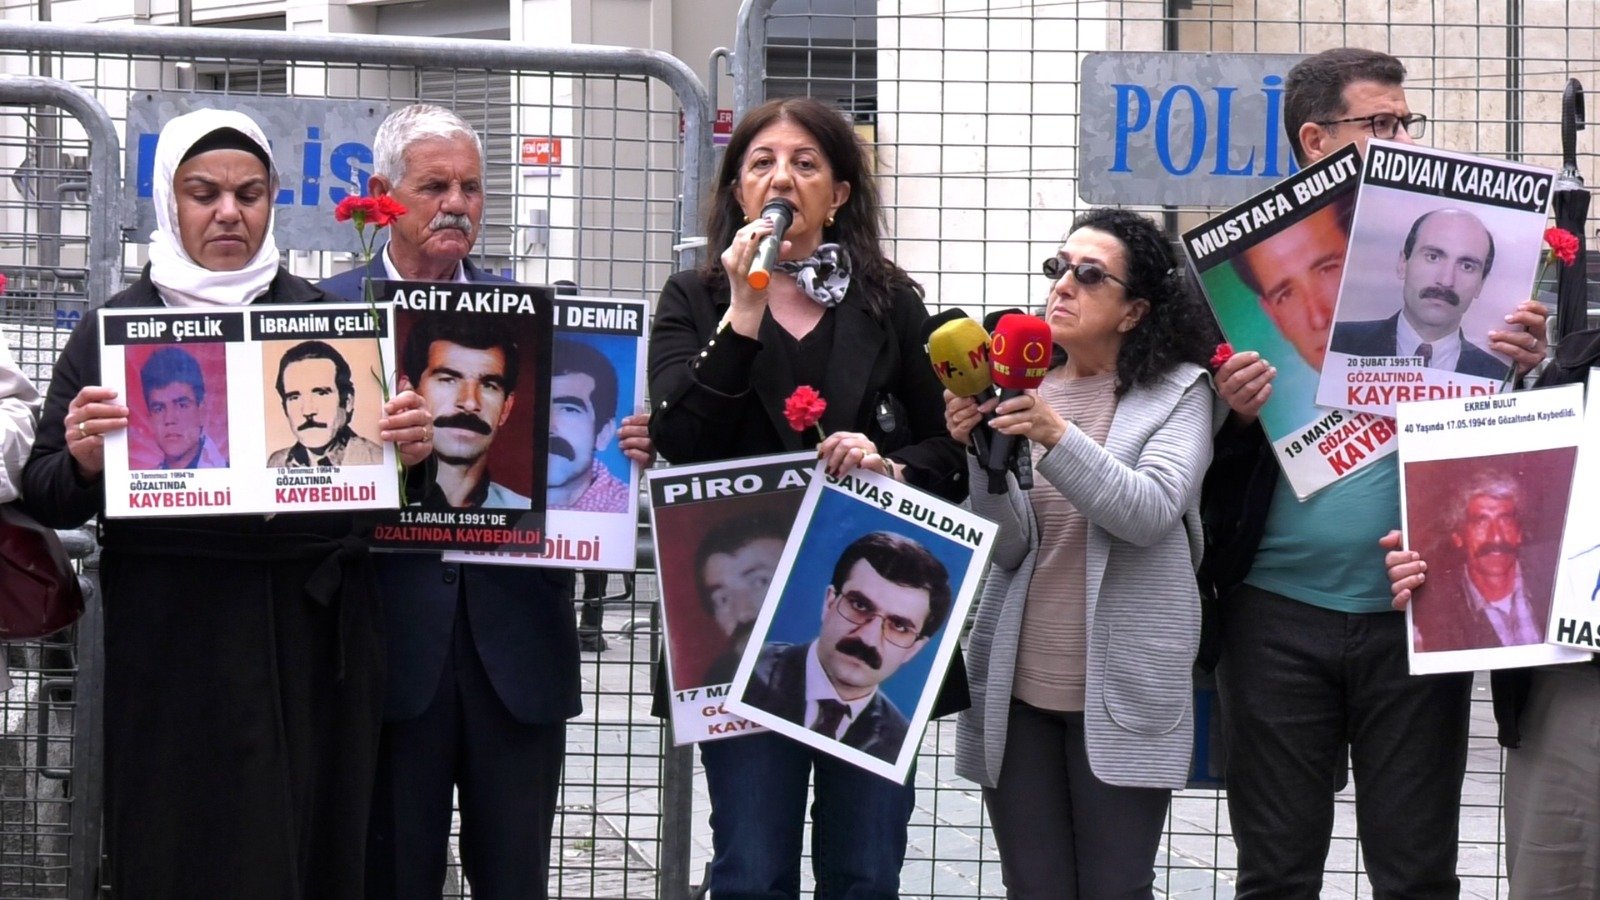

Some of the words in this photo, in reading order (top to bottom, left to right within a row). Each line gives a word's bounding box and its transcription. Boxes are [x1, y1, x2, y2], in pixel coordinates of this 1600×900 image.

[1108, 74, 1301, 177] POLİ
[1370, 150, 1448, 190] RIDVAN
[1451, 164, 1548, 212] KARAKOÇ
[1191, 193, 1293, 260] MUSTAFA
[1292, 153, 1358, 205] BULUT
[393, 285, 452, 311] AGİT
[455, 288, 536, 315] AKİPA
[126, 317, 166, 339] EDİP
[172, 315, 223, 341] ÇELİK
[259, 314, 330, 334] İBRAHİM
[566, 304, 638, 331] DEMİR
[1347, 358, 1358, 367] 20
[1360, 358, 1388, 369] ŞUBAT
[1390, 358, 1422, 367] 1995'TE
[1347, 370, 1424, 383] GÖZALTINDA
[1464, 400, 1491, 412] EKREM
[1493, 398, 1517, 409] BULUT
[1285, 441, 1303, 458] 19
[1301, 410, 1344, 446] MAYIS
[1404, 423, 1414, 433] 40
[1416, 422, 1445, 434] Yaşında
[1498, 413, 1536, 425] Gözaltında
[130, 480, 187, 491] GÖZALTINDA
[276, 475, 333, 486] GÖZALTINDA
[663, 473, 764, 504] PİRO
[129, 486, 231, 508] KAYBEDİLDİ
[275, 481, 376, 504] KAYBEDİLDİ
[400, 511, 413, 523] 11
[415, 512, 456, 524] ARALIK
[458, 513, 507, 526] 1991'DE
[898, 498, 984, 547] BULDAN
[455, 528, 541, 545] KAYBEDİLDİ
[676, 690, 699, 702] 17
